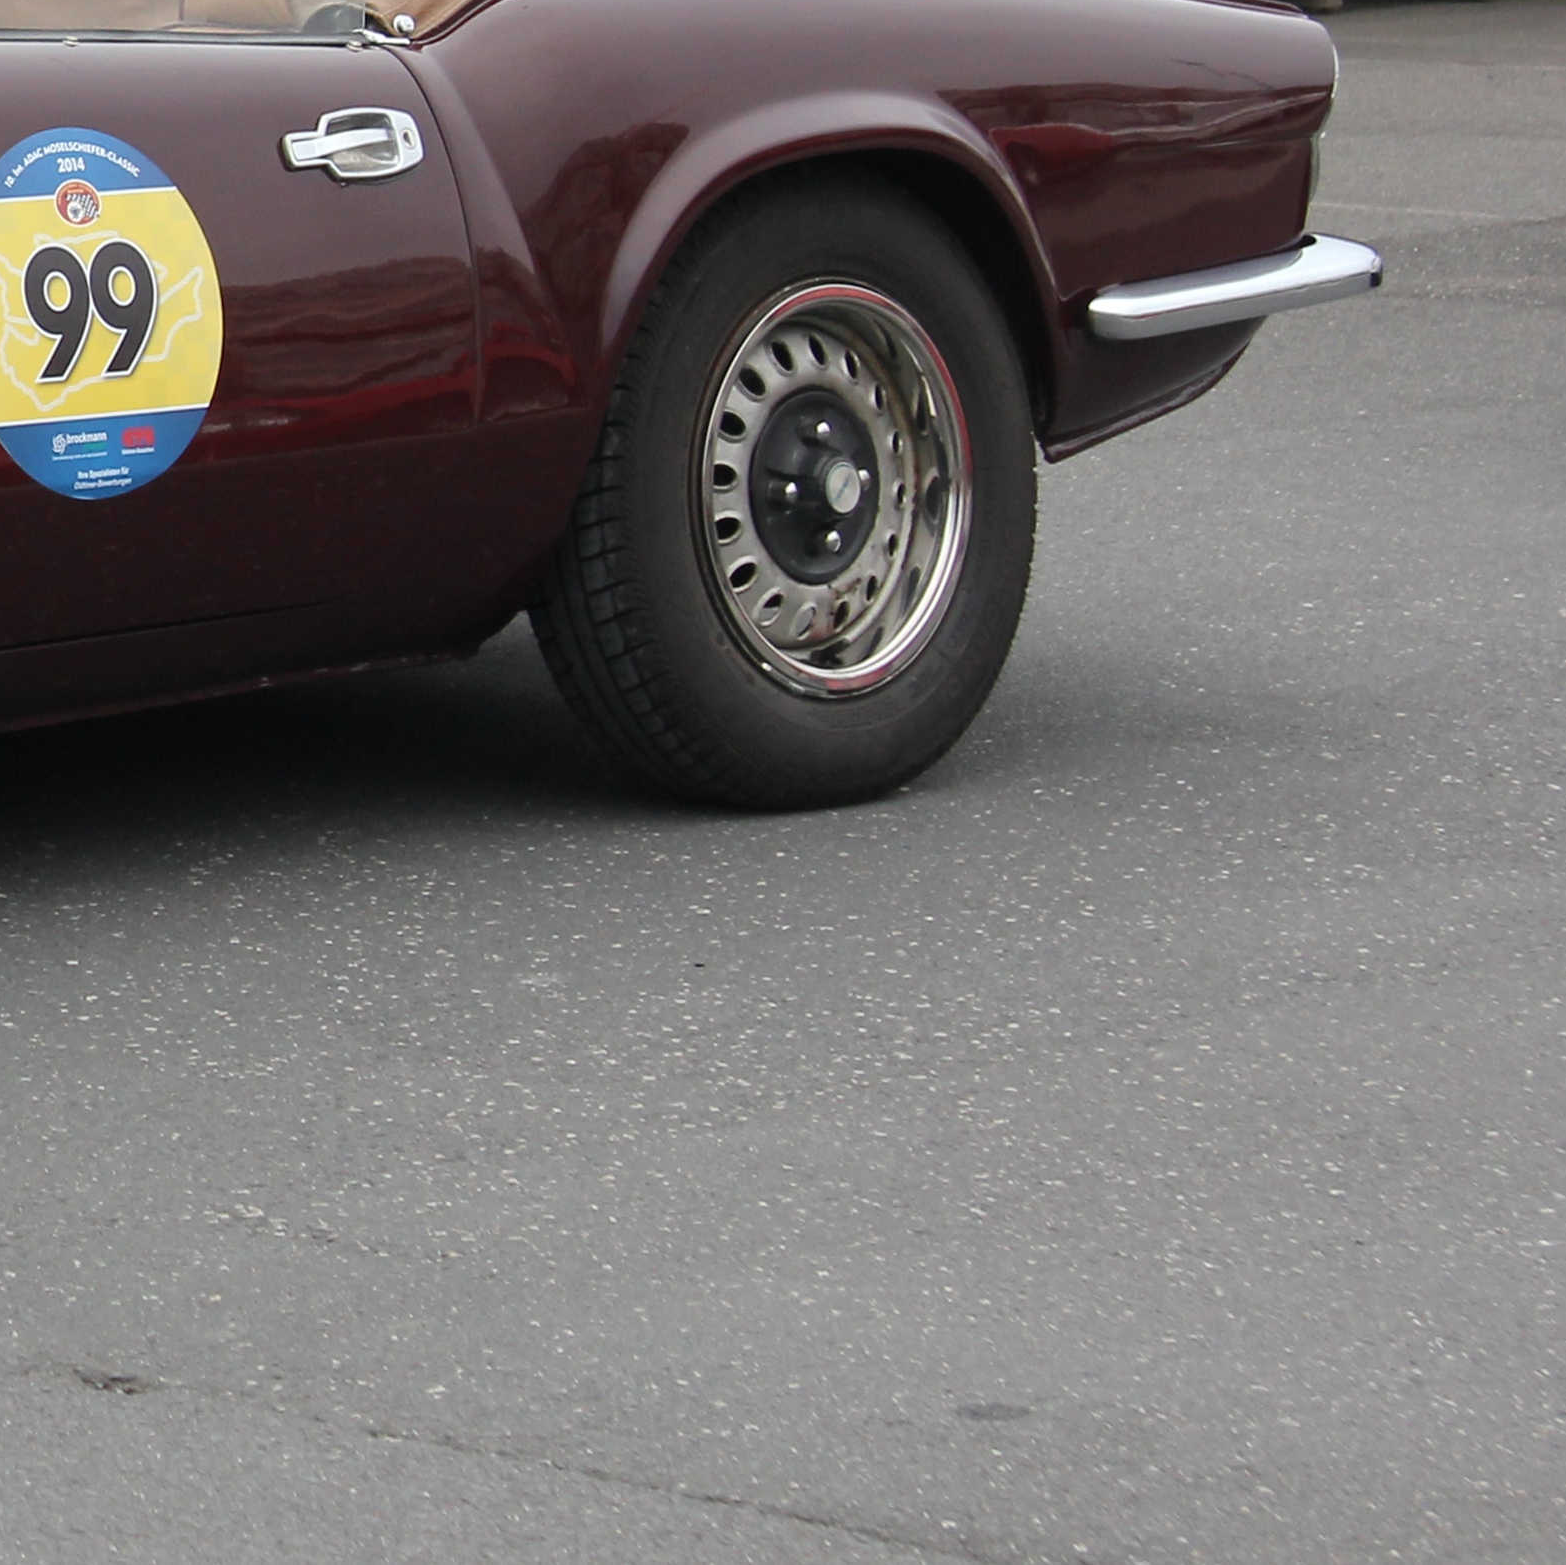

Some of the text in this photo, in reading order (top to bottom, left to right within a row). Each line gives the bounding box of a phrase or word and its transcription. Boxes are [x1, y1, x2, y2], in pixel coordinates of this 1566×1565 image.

[23, 146, 44, 168] ADAC
[43, 140, 142, 179] MOSELSCHIEFER-CLASSIC
[56, 156, 86, 174] 2014
[23, 237, 159, 384] 99
[66, 432, 108, 444] brockmann
